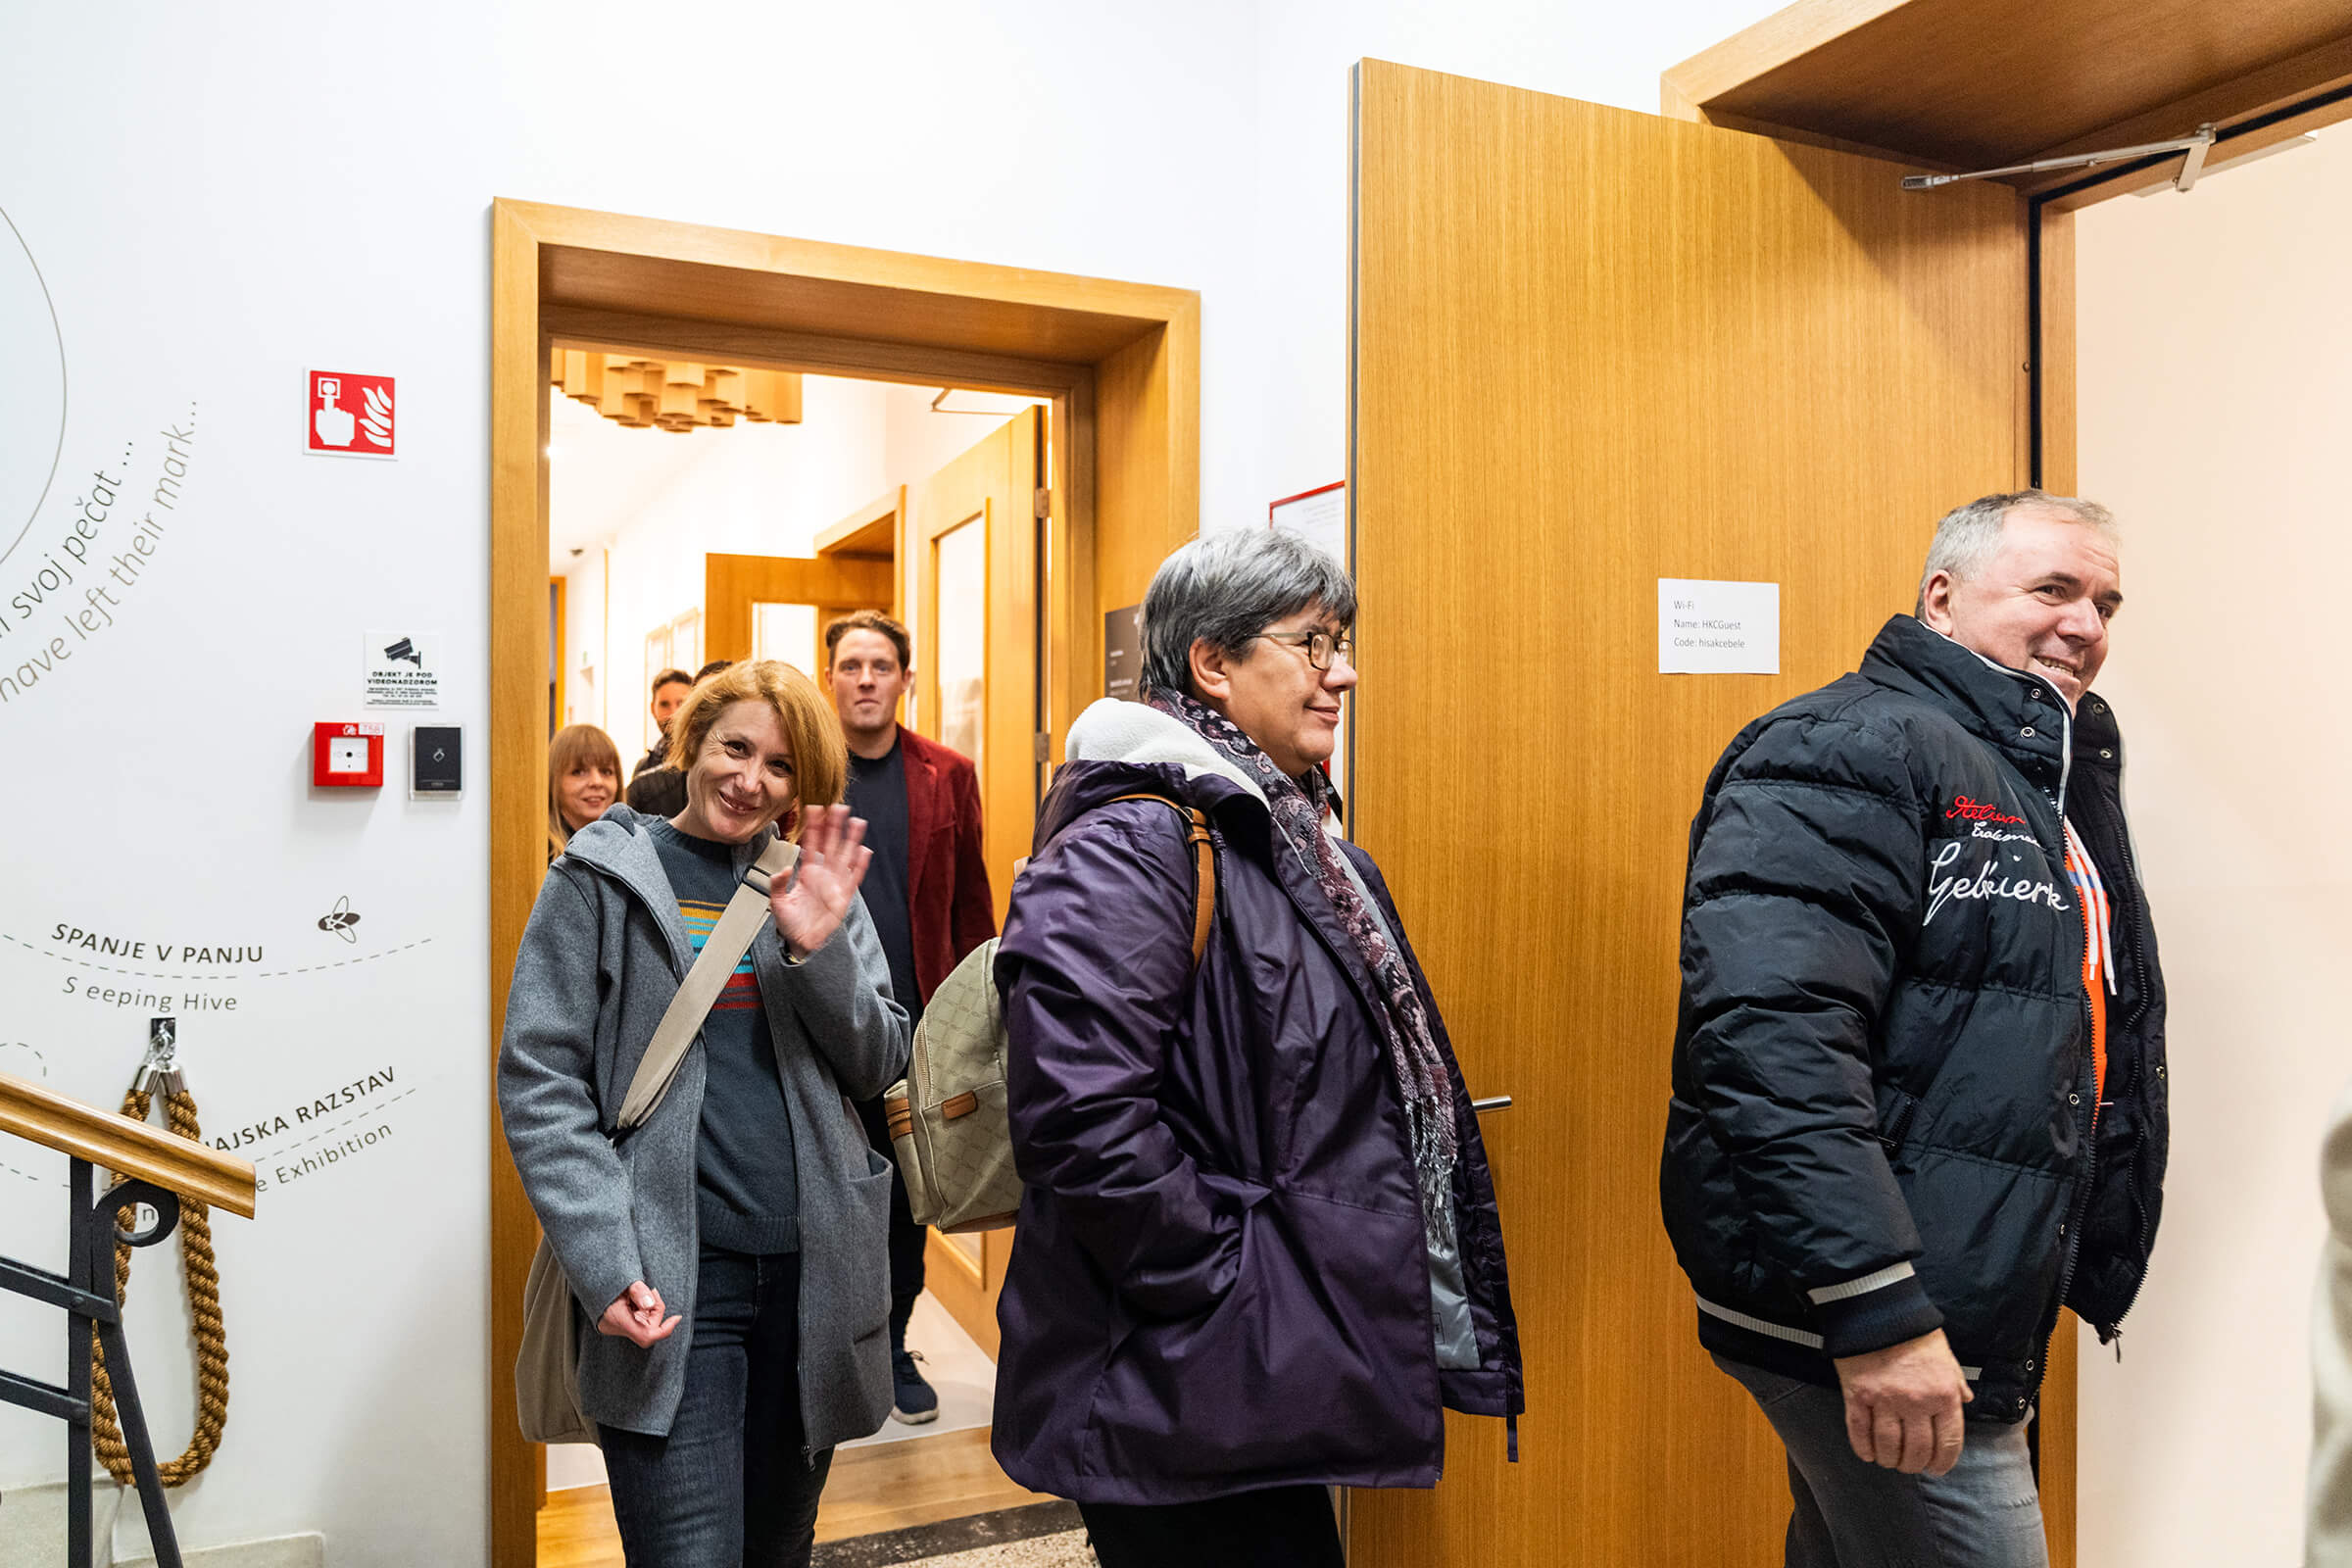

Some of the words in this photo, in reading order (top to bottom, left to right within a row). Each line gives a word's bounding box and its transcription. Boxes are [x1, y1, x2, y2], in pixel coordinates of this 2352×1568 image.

[12, 553, 74, 618] svoj
[62, 469, 122, 565] pečat
[64, 586, 120, 640] left
[109, 512, 164, 586] their
[1674, 601, 1693, 610] Wi-Fi
[1674, 619, 1700, 628] Name:
[1702, 620, 1740, 630] HKCGuest
[1674, 638, 1697, 647] Code:
[51, 923, 146, 959] SPANJE
[156, 945, 172, 961] V
[182, 946, 263, 963] PANJU
[183, 993, 237, 1010] Hive
[205, 1115, 290, 1152] AJSKA
[295, 1065, 394, 1123] RAZSTAV
[275, 1124, 392, 1184] Exhibition
